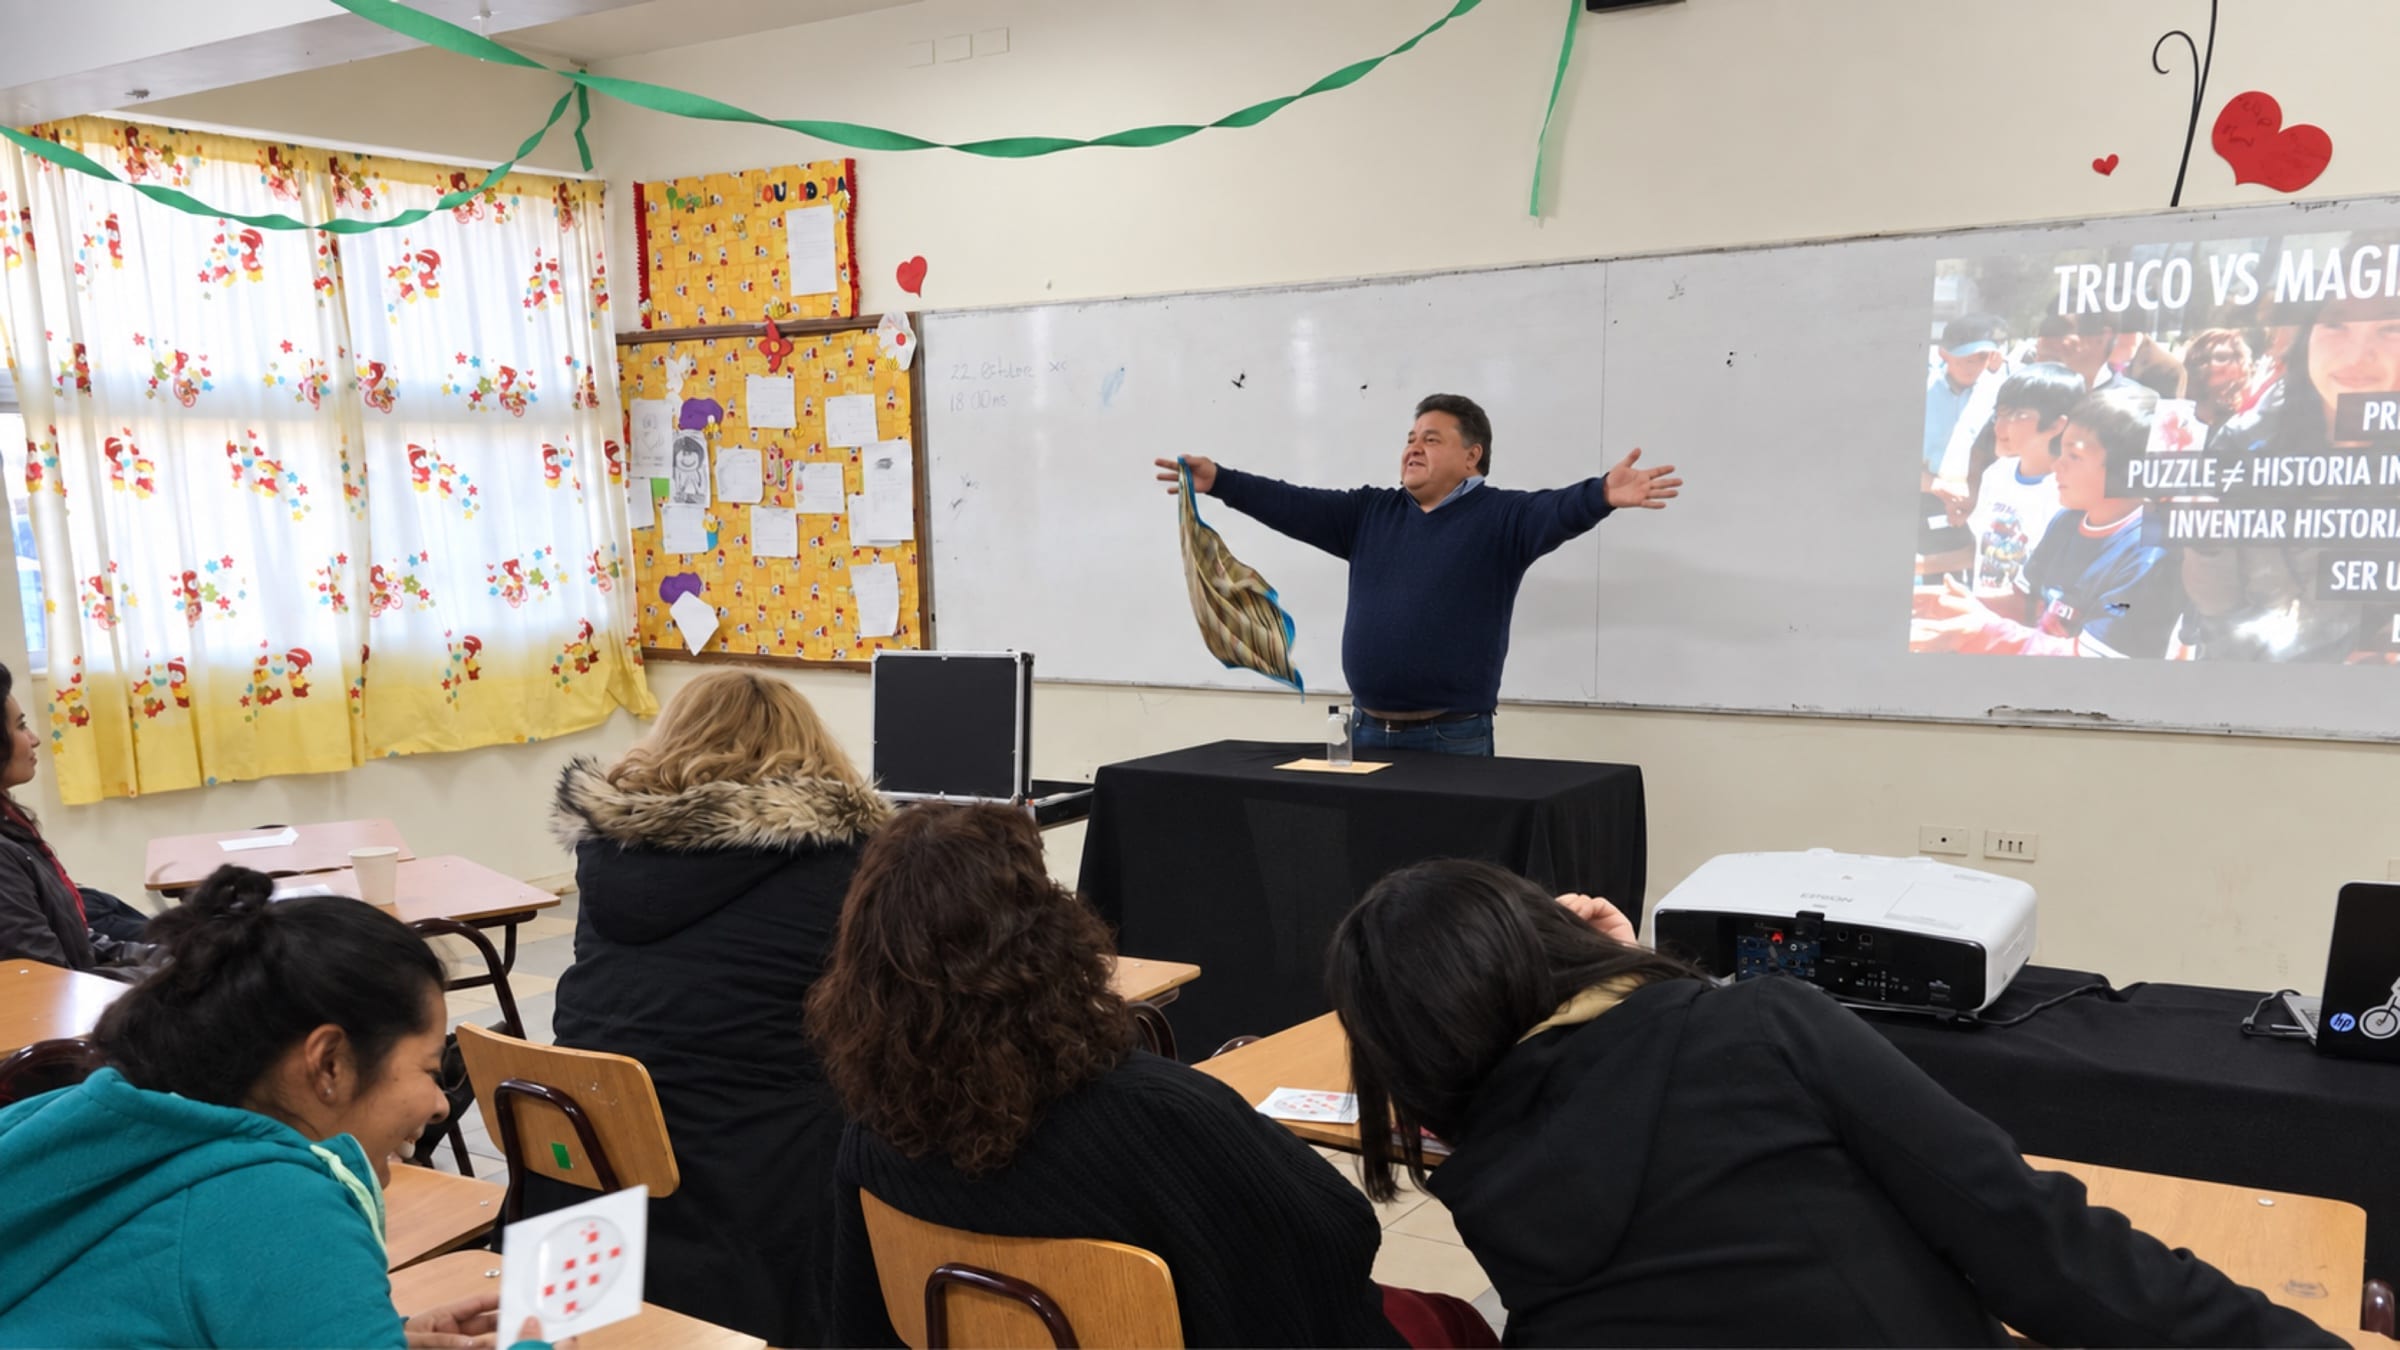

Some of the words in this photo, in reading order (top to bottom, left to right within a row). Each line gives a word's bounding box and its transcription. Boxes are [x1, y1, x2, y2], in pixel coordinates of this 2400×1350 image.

[2053, 257, 2193, 316] TRUCO
[2209, 252, 2261, 307] VS
[2273, 244, 2400, 304] MAGI
[2362, 400, 2400, 431] PR
[2127, 457, 2218, 488] PUZZLE
[2252, 455, 2372, 487] HISTORIA
[2168, 508, 2287, 539] INVENTAR
[2293, 508, 2400, 539] HISTORI
[2330, 560, 2379, 591] SER
